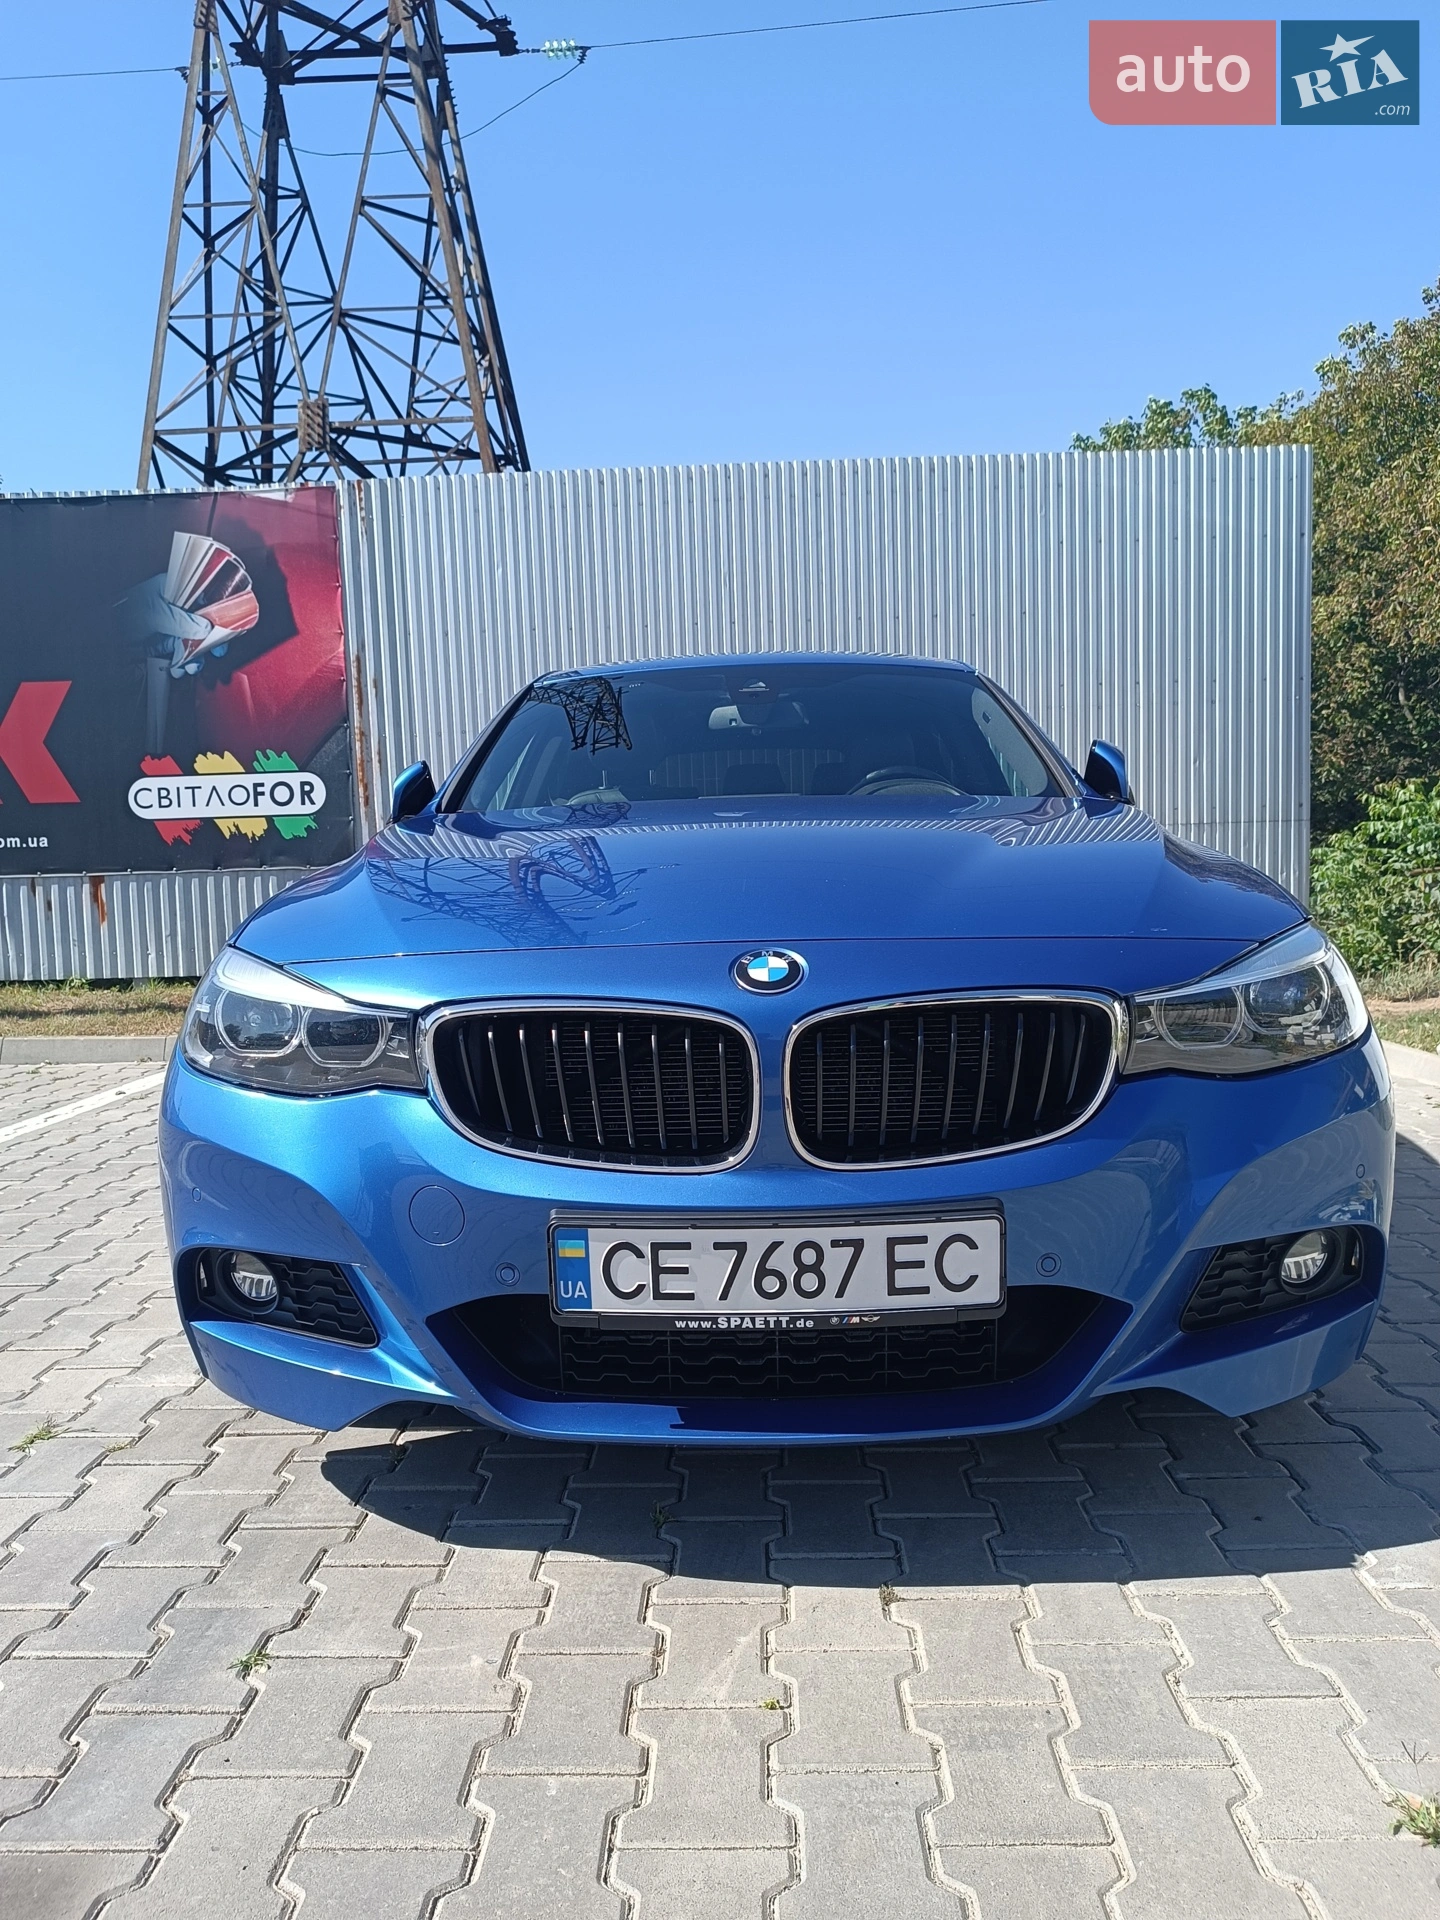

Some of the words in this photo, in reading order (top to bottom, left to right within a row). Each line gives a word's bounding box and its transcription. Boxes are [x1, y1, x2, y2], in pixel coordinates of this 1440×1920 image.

[741, 950, 795, 963] BMW
[601, 1241, 695, 1301] CE
[712, 1238, 865, 1301] 7687
[886, 1234, 979, 1297] EC
[560, 1280, 588, 1299] UA
[675, 1316, 814, 1329] www.SPAETT.de
